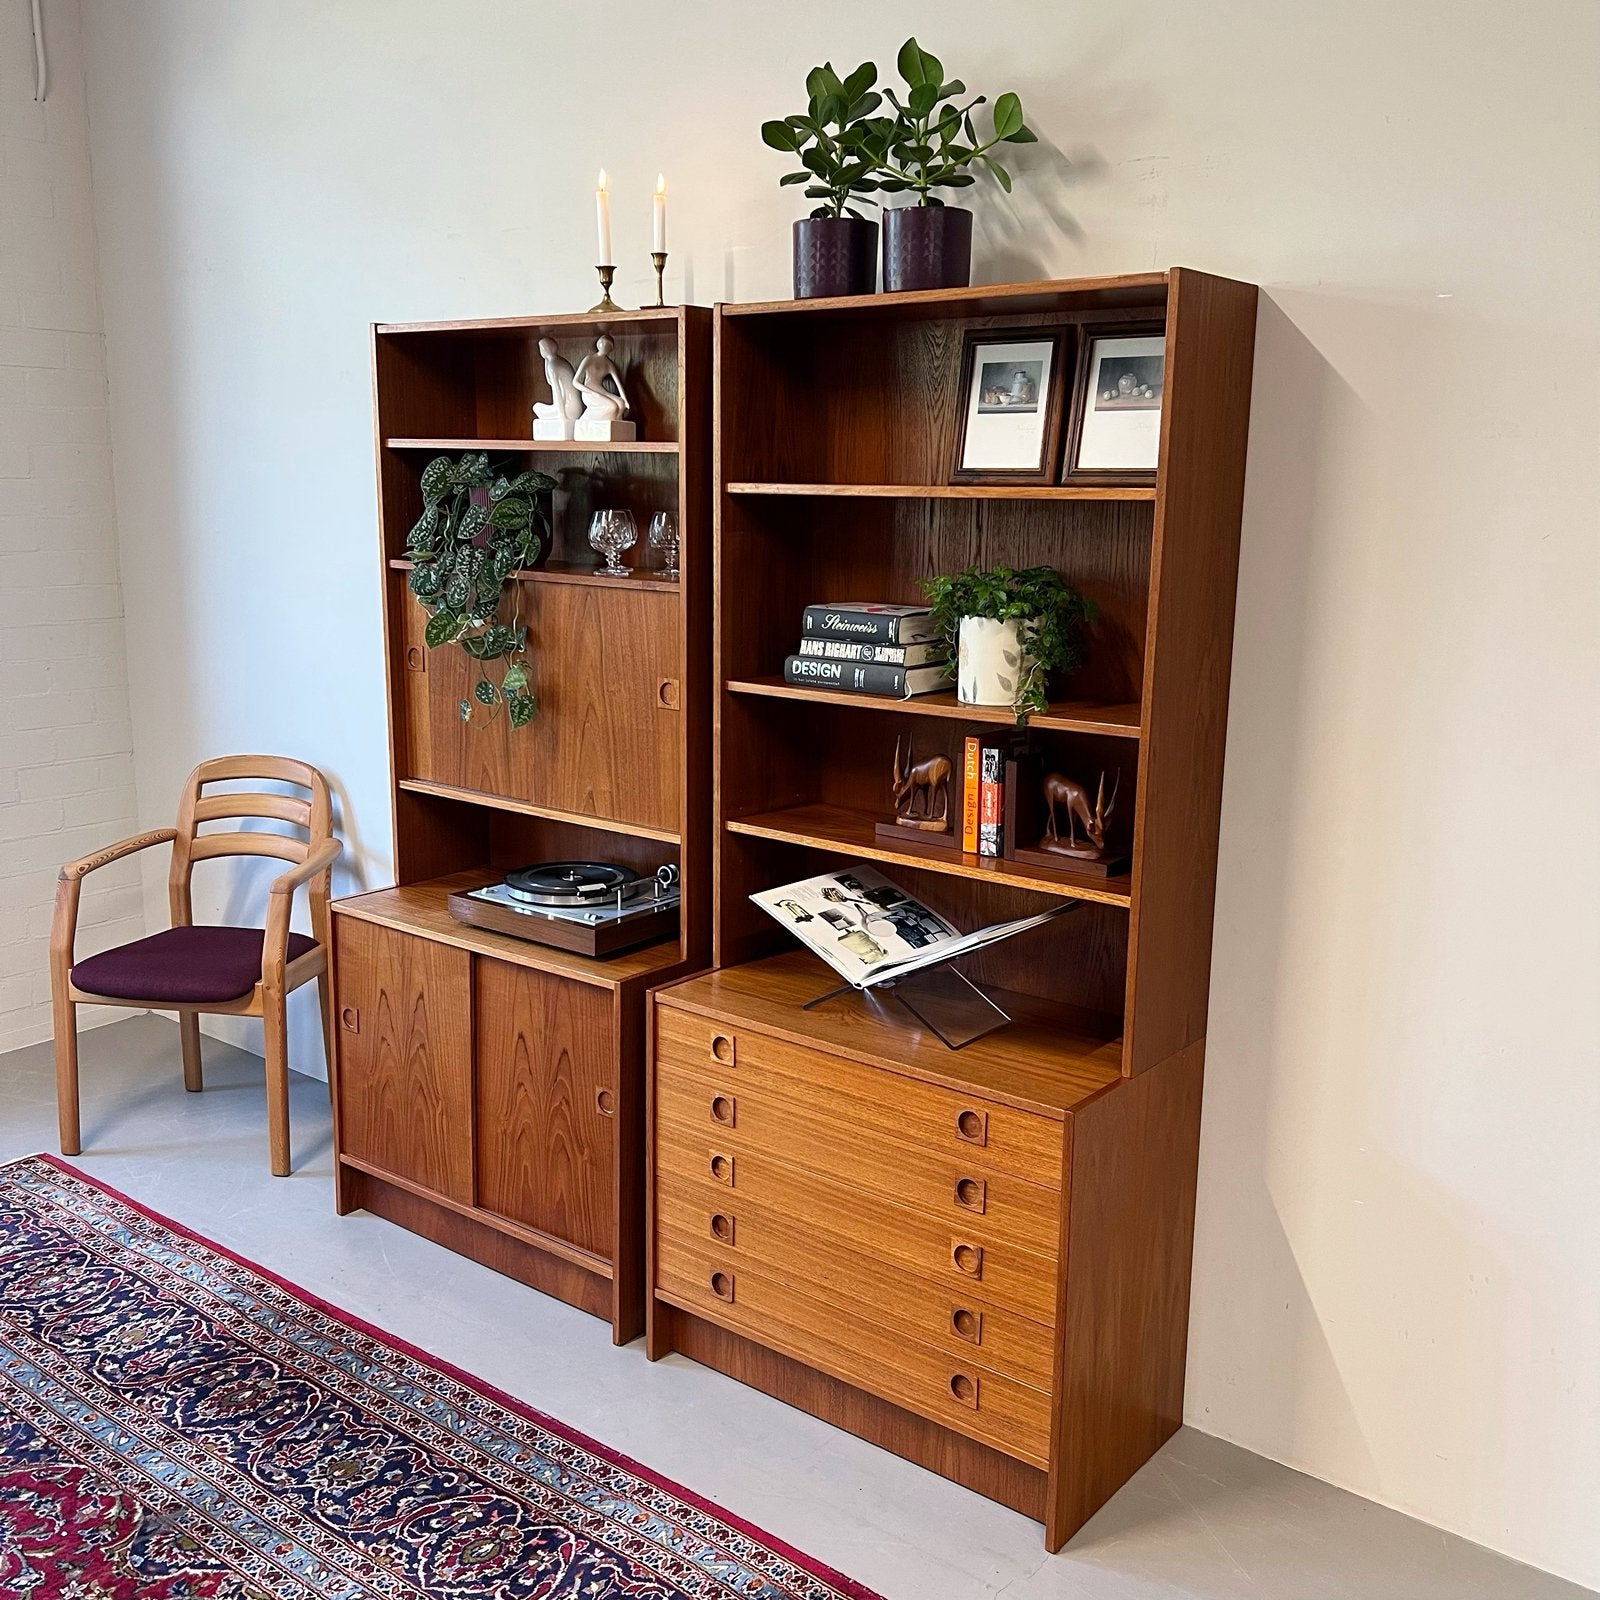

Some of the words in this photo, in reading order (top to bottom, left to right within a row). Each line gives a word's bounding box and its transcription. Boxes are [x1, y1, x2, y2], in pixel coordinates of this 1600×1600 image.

[821, 614, 878, 634] Steinweiss
[799, 639, 824, 656] HANS
[824, 641, 863, 660] RIGHART
[792, 660, 842, 679] DESIGN
[966, 742, 977, 779] Dutch
[965, 793, 977, 835] Design
